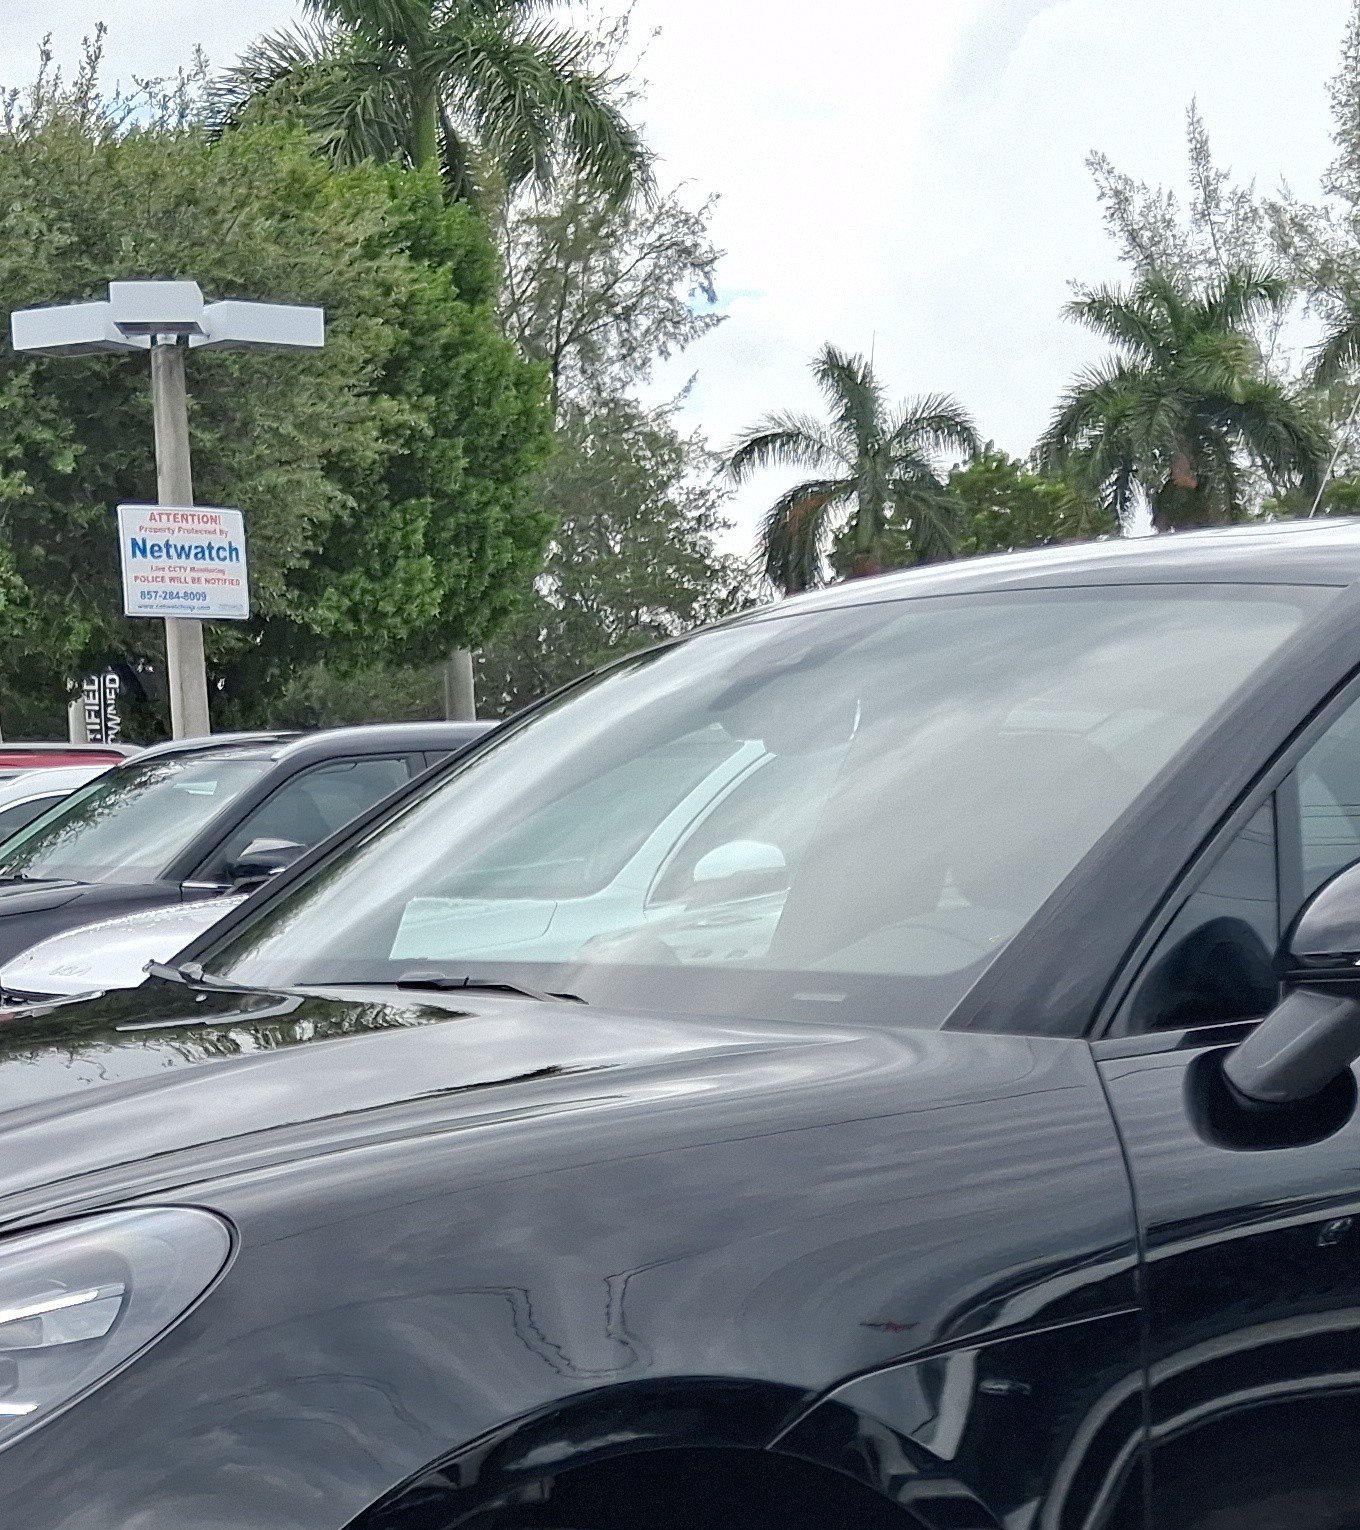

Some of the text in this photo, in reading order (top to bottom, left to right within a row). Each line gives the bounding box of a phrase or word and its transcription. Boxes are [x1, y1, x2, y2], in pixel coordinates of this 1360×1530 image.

[149, 512, 222, 525] ATTENTION!
[139, 525, 175, 536] Property
[178, 526, 217, 535] Protected
[131, 537, 240, 562] Netwatch
[134, 575, 166, 583] POLICE
[169, 576, 189, 584] WILL
[204, 578, 240, 586] NOTIFIED
